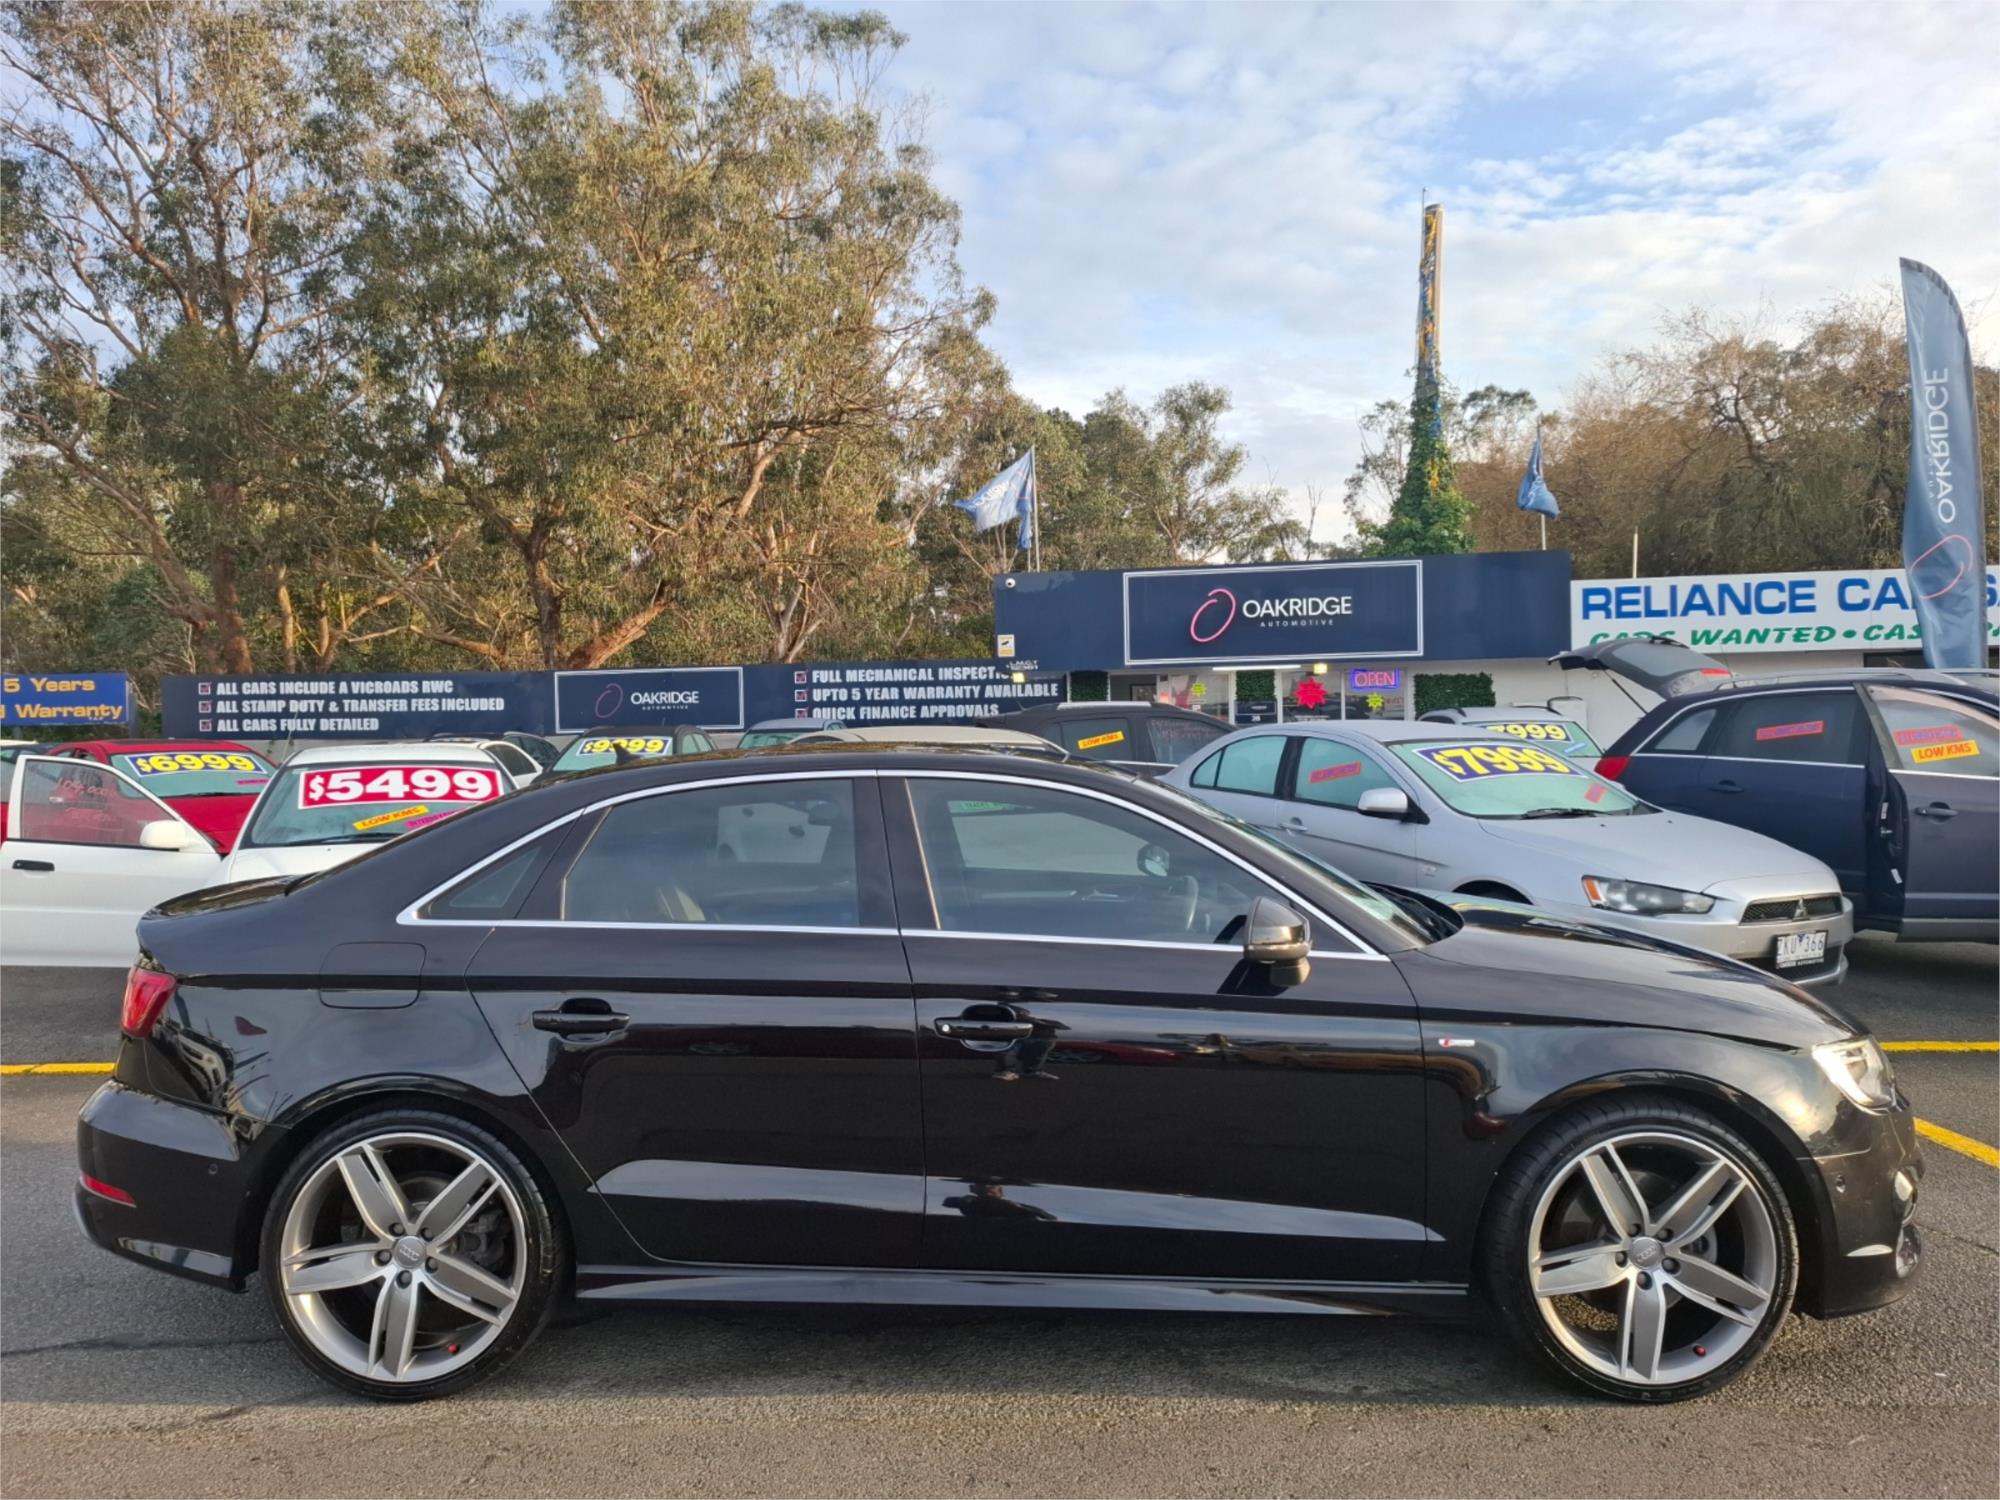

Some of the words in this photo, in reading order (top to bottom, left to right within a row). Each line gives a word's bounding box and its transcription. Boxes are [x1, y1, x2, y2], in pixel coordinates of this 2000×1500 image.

[1582, 579, 1817, 620] RELIANCE
[1837, 576, 1910, 612] CA
[1242, 596, 1352, 618] OAKRIDGE
[1260, 619, 1334, 628] AUTOMOTIVE
[1690, 625, 1838, 646] WANTED
[1862, 624, 1921, 640] CAS
[812, 670, 842, 683] FULL
[846, 668, 934, 682] MECHANICAL
[1355, 671, 1395, 687] OPEN
[3, 678, 20, 693] 5
[29, 677, 96, 692] Years
[216, 682, 239, 695] ALL
[241, 681, 277, 694] CARS
[280, 681, 336, 694] INCLUDE
[338, 681, 349, 694] A
[351, 681, 419, 694] VICROADS
[422, 680, 454, 693] RWC
[812, 688, 848, 701] UPTO
[851, 688, 861, 700] 5
[865, 686, 899, 700] YEAR
[903, 684, 981, 699] WARRANTY
[984, 683, 1058, 698] AVAILABLE
[216, 700, 239, 713] ALL
[241, 700, 286, 713] STAMP
[289, 699, 325, 713] DUTY
[328, 701, 339, 712] &
[343, 699, 408, 712] TRANSFER
[411, 698, 439, 711] FEES
[441, 697, 505, 711] INCLUDED
[630, 691, 700, 705] OAKRIDGE
[15, 704, 122, 719] Warranty
[812, 706, 856, 720] QUICK
[860, 705, 917, 719] FINANCE
[920, 704, 999, 719] APPROVALS
[217, 719, 239, 732] ALL
[242, 719, 277, 732] CARS
[280, 719, 316, 732] FULLY
[319, 718, 379, 732] DETAILED
[1918, 747, 1945, 760] LOW
[1947, 744, 1972, 756] KMS
[136, 754, 255, 772] $6999
[1432, 747, 1570, 775] $7999
[309, 769, 492, 800] $5499
[361, 814, 390, 827] LOW
